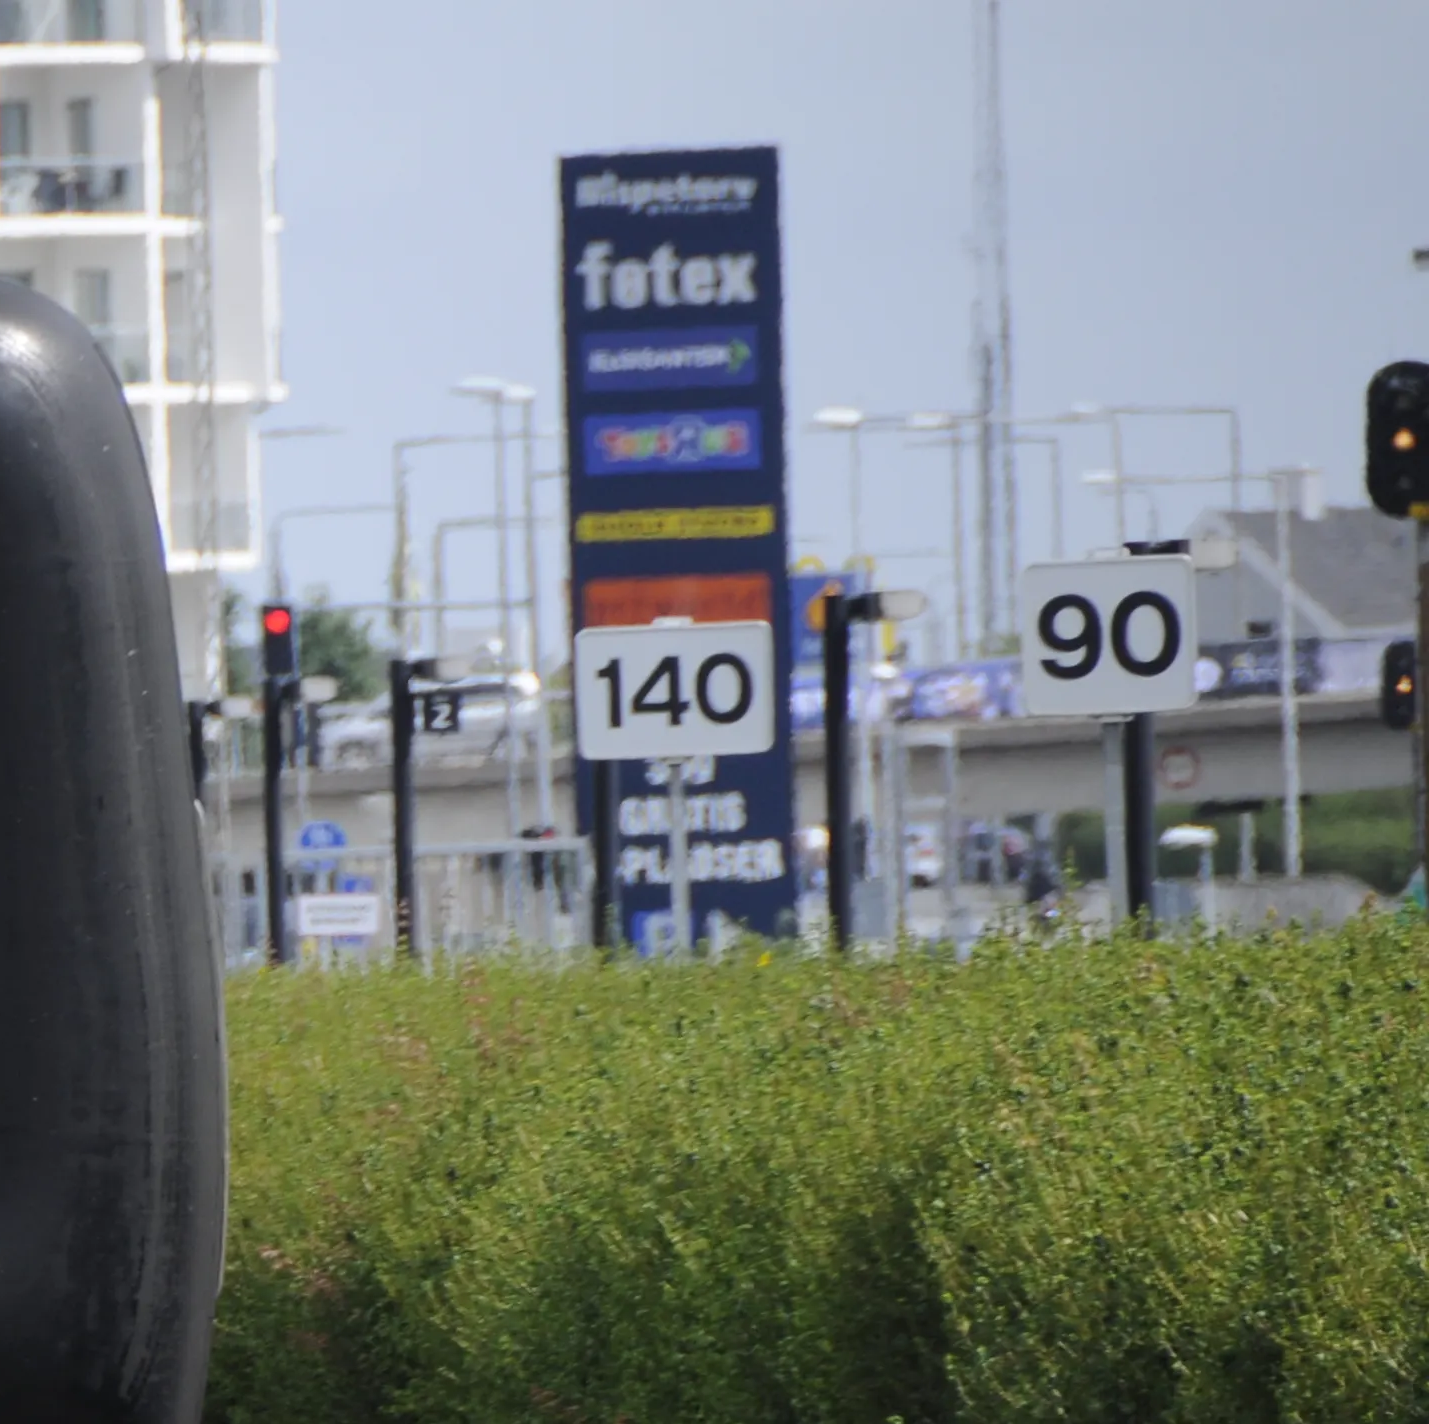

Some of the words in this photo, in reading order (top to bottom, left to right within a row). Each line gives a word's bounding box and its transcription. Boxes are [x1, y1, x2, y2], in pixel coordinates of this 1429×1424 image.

[1038, 590, 1181, 679] 90
[430, 704, 453, 728] 2
[597, 653, 753, 728] 140
[619, 793, 747, 836] GRTIS
